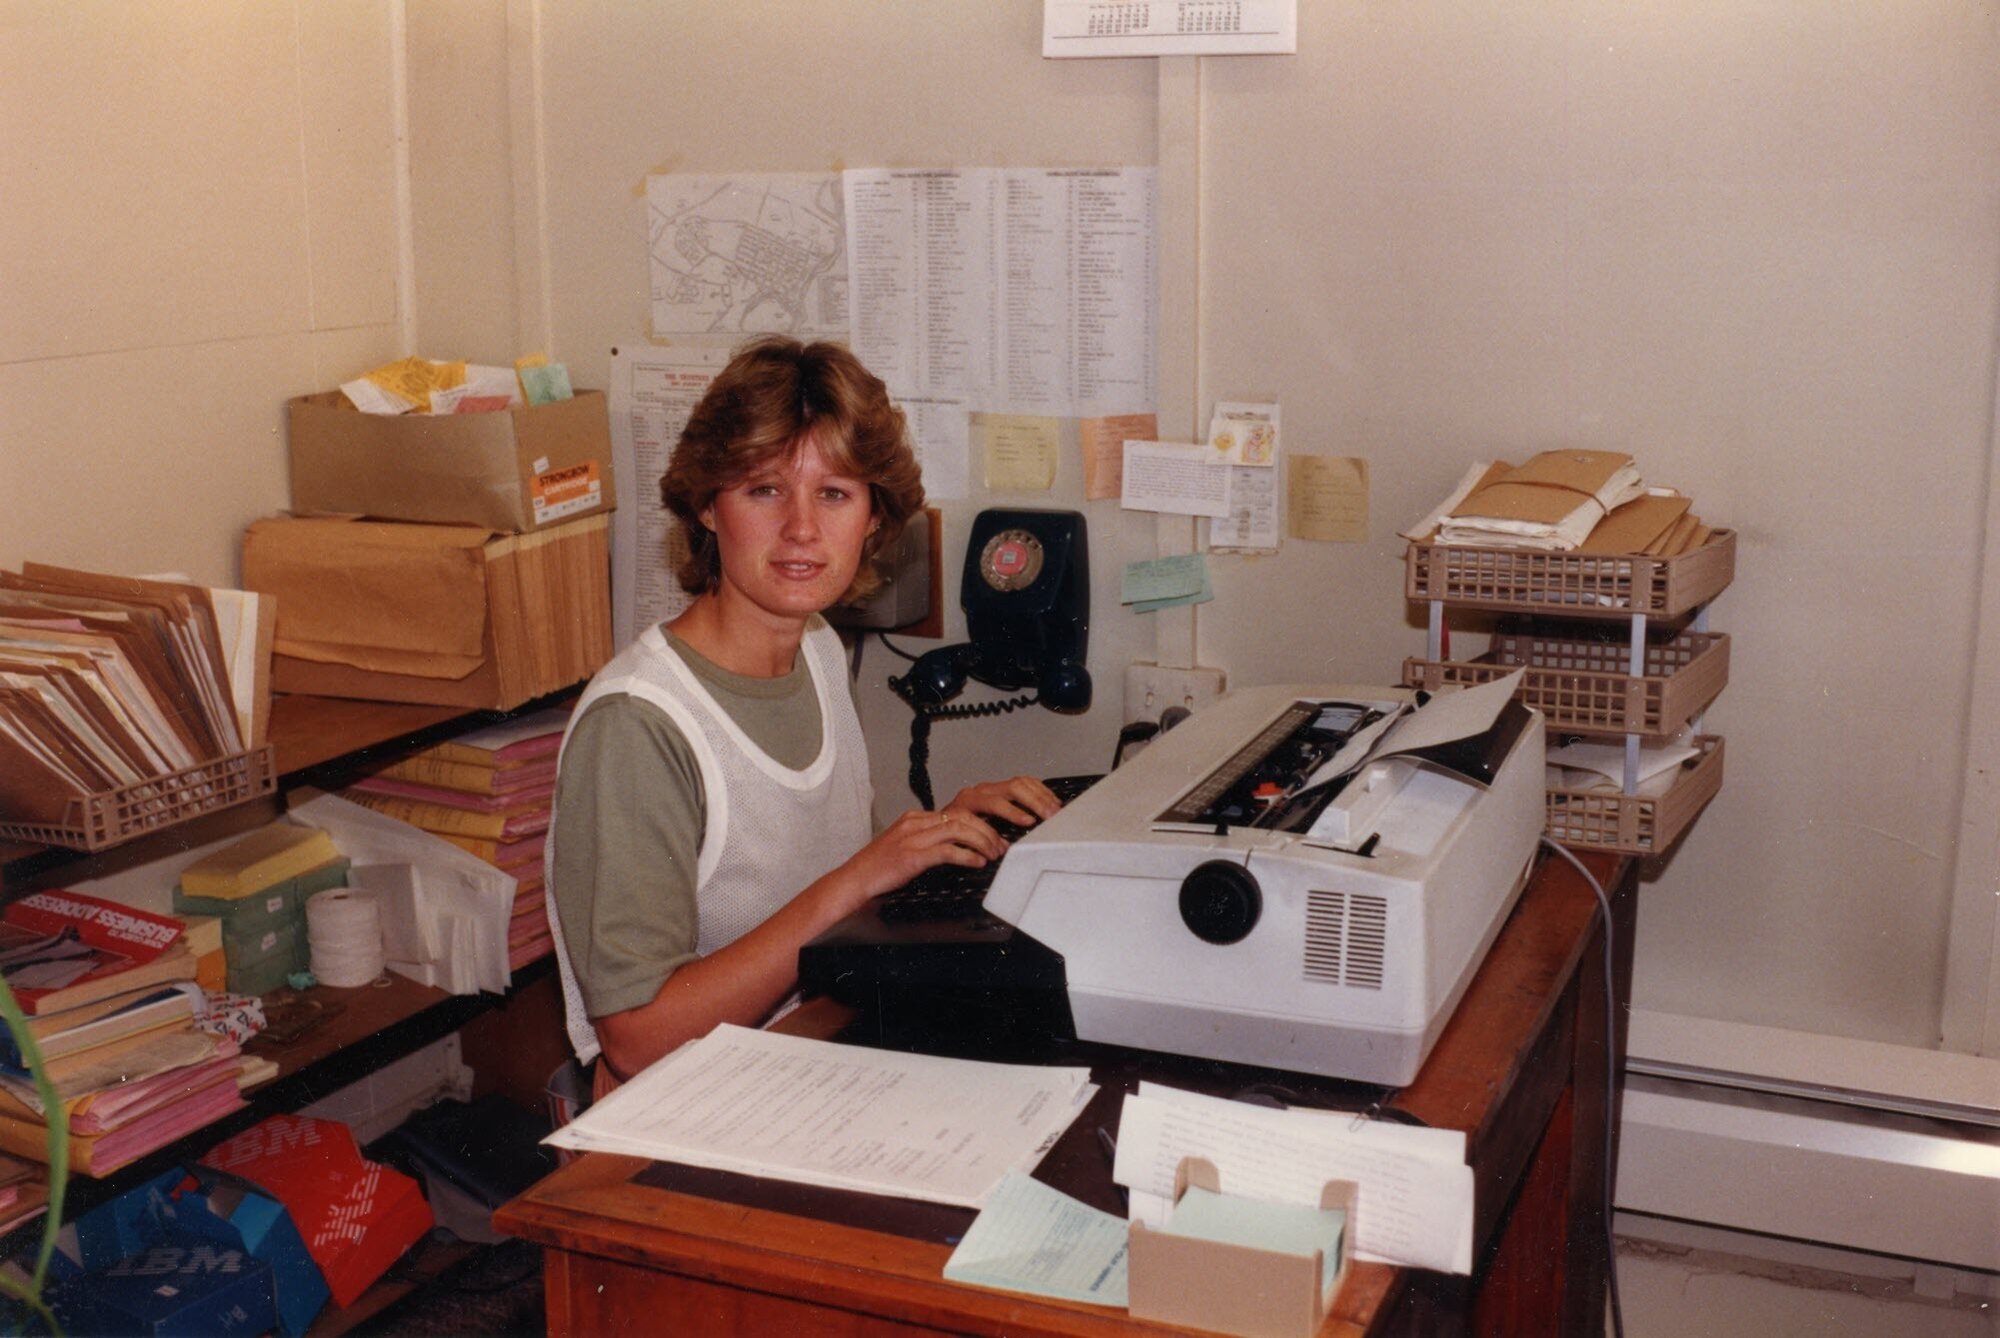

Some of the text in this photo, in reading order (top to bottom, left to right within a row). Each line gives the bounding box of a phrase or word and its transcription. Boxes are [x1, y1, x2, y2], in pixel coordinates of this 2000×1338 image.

[95, 909, 179, 943] BUSINESS
[203, 1117, 322, 1170] IBM
[105, 1246, 243, 1277] IBM
